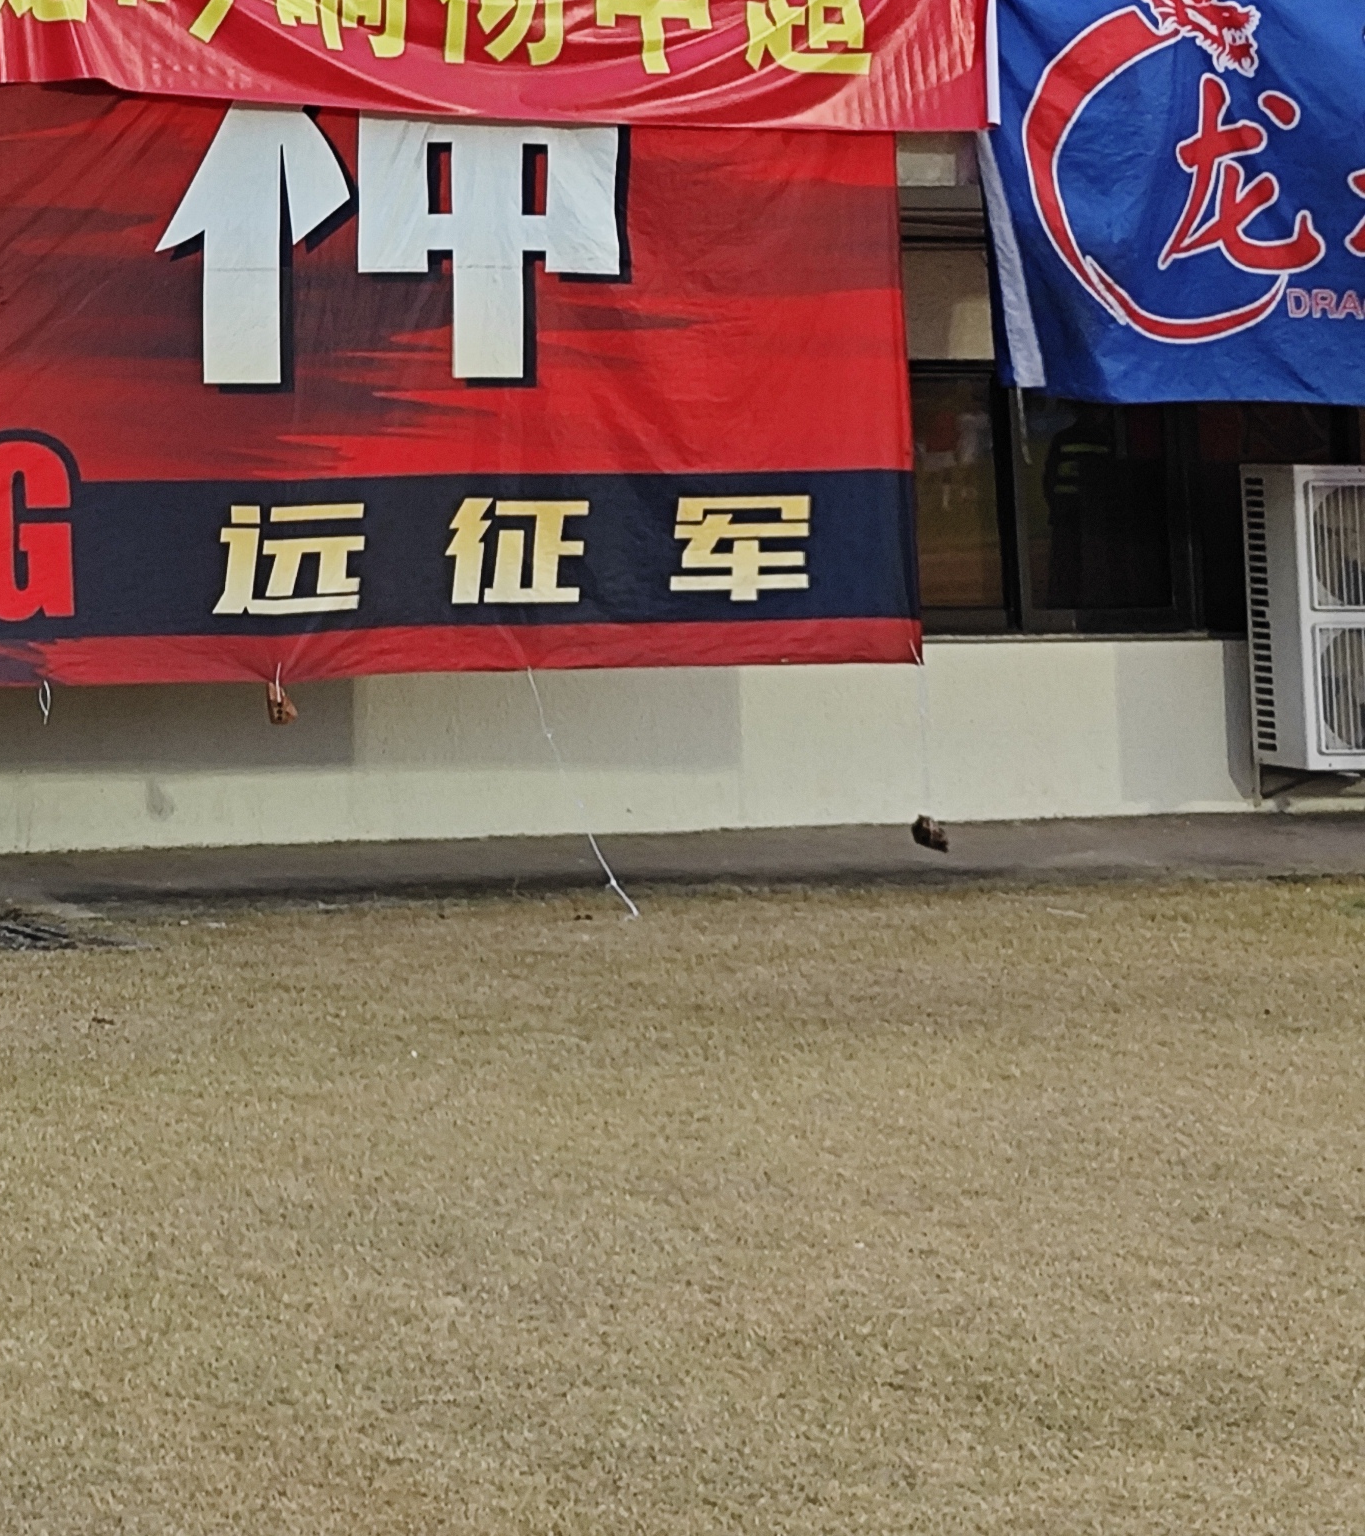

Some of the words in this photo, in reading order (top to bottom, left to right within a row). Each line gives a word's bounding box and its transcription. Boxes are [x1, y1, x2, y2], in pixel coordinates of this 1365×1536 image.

[1157, 72, 1365, 275] 龙
[1286, 287, 1365, 321] DRA
[212, 494, 814, 615] 远征军
